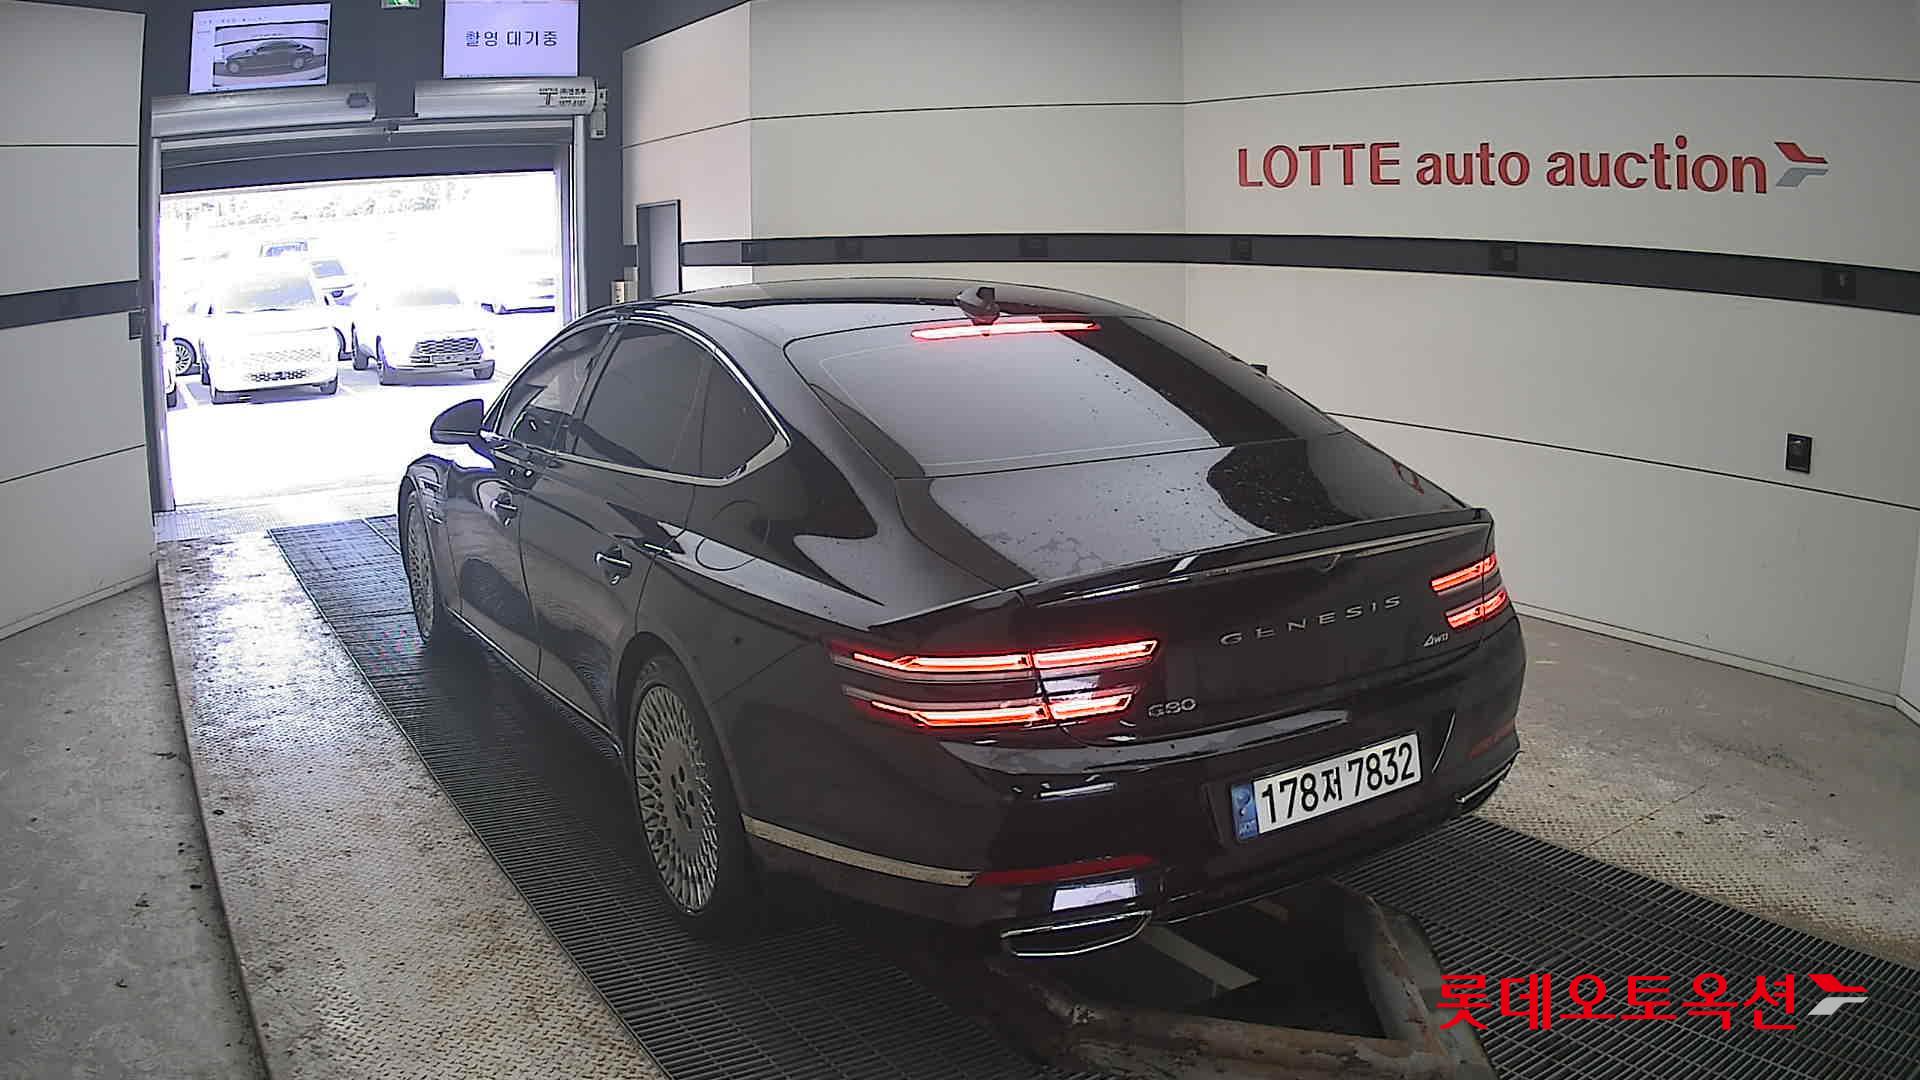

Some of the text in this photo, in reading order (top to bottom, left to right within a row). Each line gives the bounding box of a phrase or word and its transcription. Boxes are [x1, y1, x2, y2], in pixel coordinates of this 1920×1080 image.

[1237, 135, 1768, 194] LOTTE auto auction
[1219, 595, 1402, 646] GENESIS
[1261, 742, 1415, 824] 178저 7832
